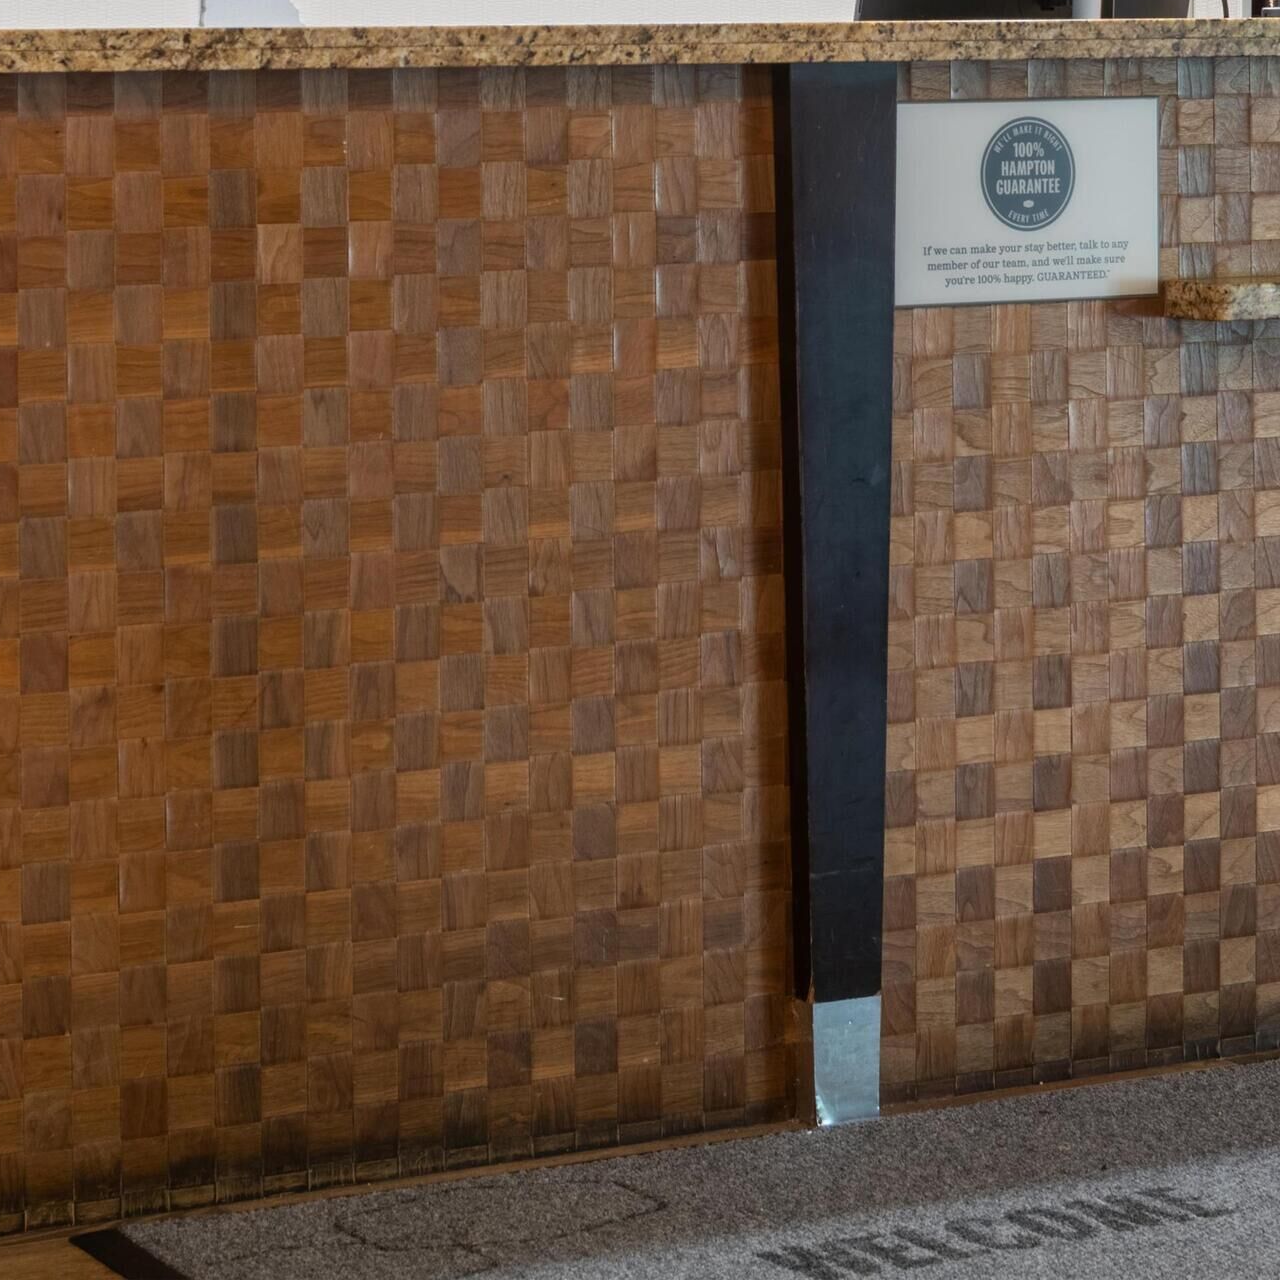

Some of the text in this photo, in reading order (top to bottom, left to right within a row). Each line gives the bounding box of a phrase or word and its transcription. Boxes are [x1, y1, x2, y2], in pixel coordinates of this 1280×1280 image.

[993, 125, 1063, 153] WE'LL MAKE IT RIGHT
[1012, 141, 1045, 158] 100%
[1001, 160, 1055, 176] HAMPTON
[995, 178, 1061, 195] GUARANTEE
[1007, 208, 1049, 224] EVERY TIME
[923, 239, 1129, 256] If we can make your stay better, talk to any
[927, 254, 1126, 271] member of our team, and we'll make sure
[945, 275, 975, 288] you're
[977, 274, 1002, 285] 100%
[1004, 273, 1035, 286] happy.
[754, 1186, 1238, 1280] WELCOME
